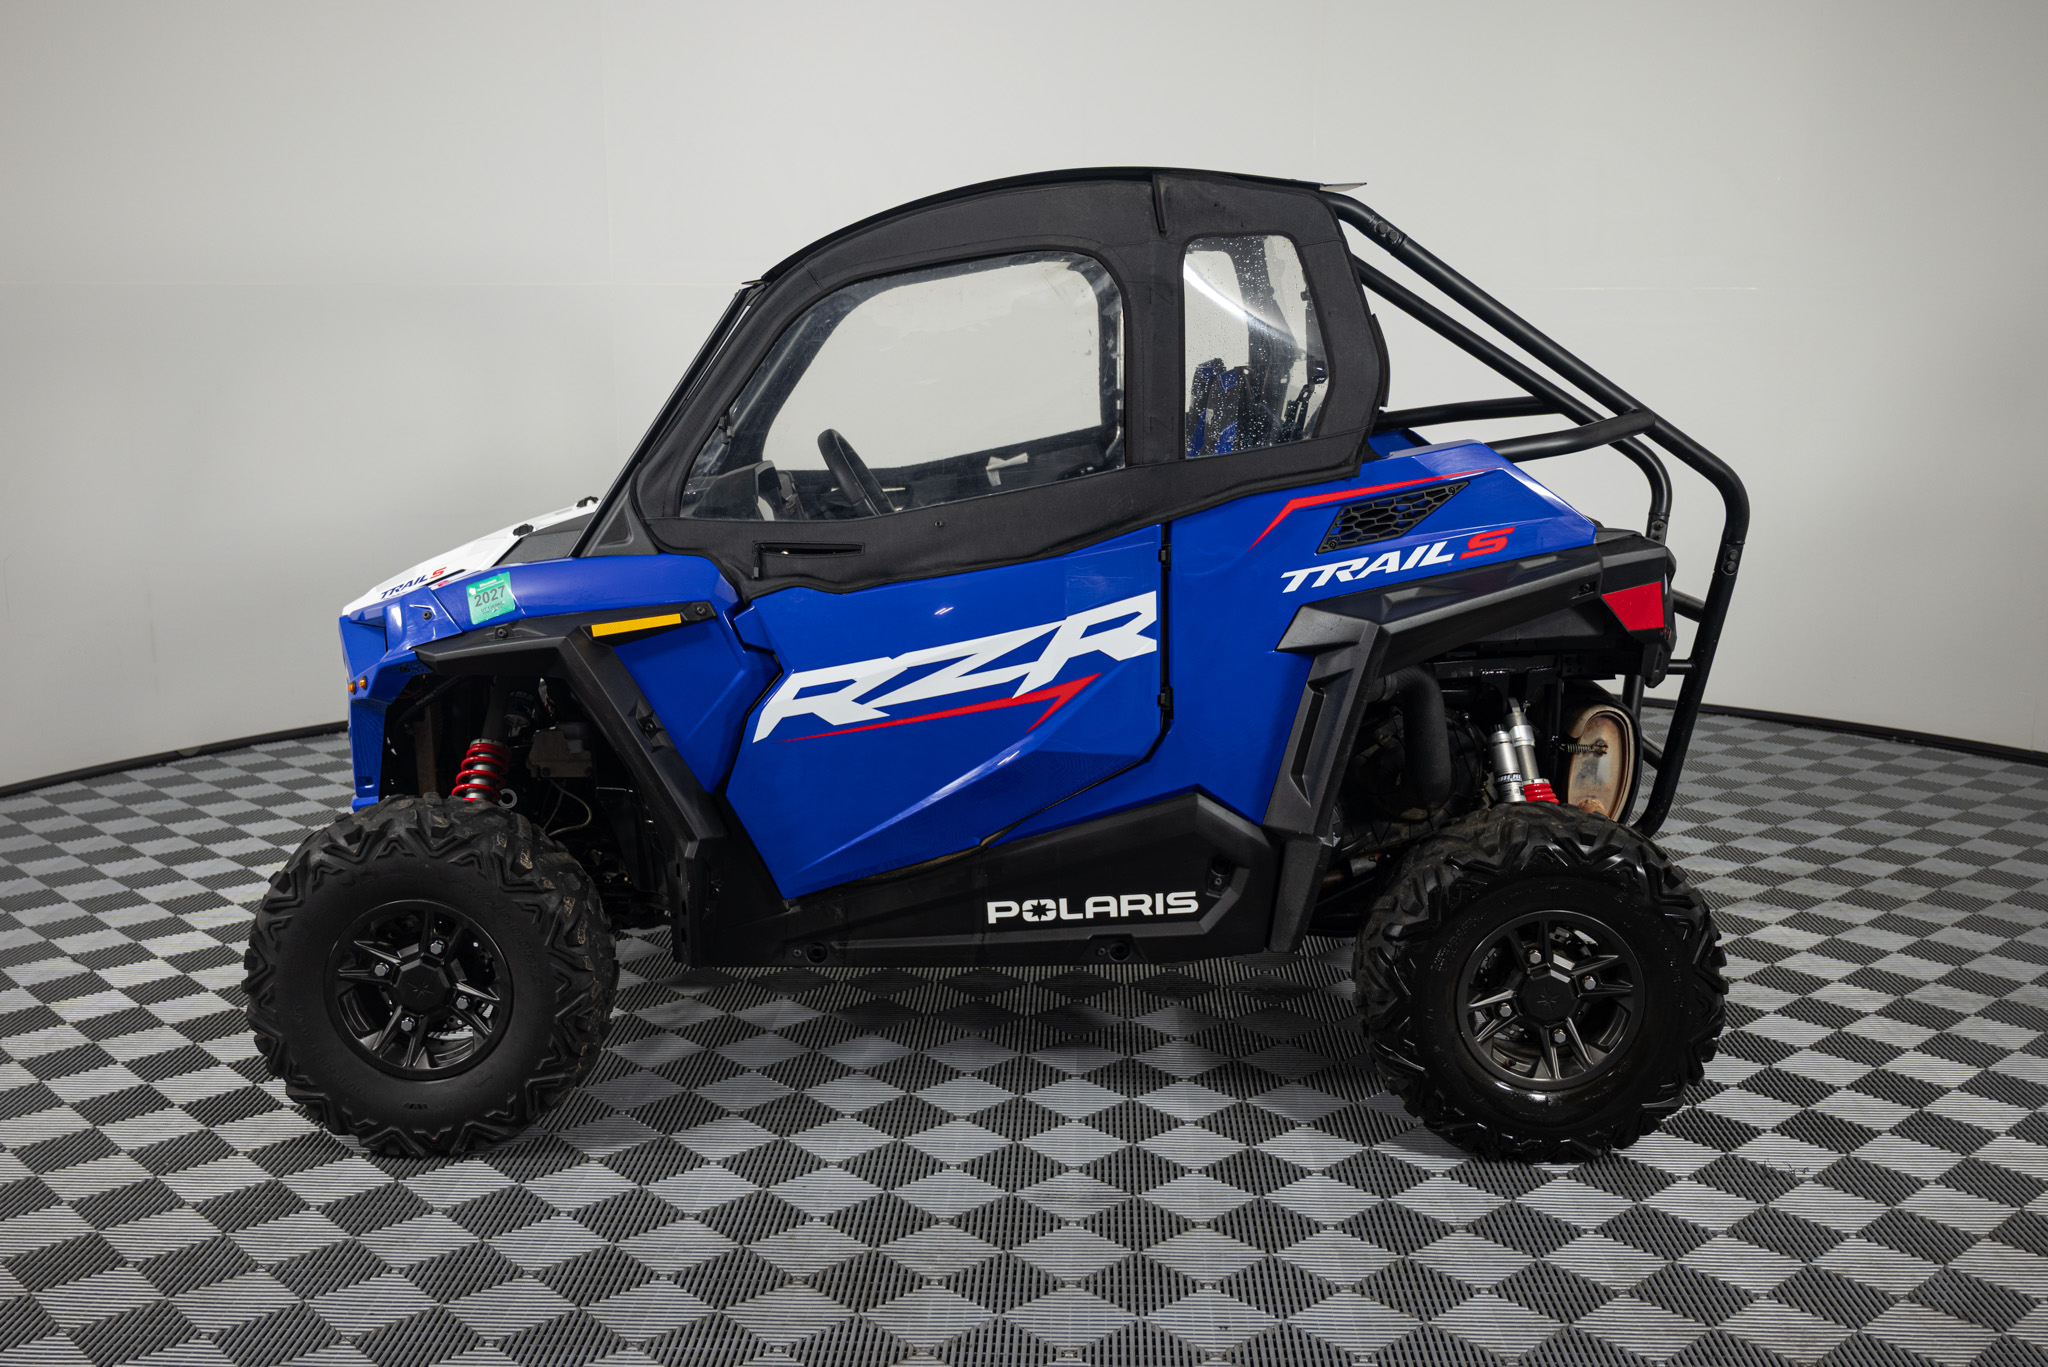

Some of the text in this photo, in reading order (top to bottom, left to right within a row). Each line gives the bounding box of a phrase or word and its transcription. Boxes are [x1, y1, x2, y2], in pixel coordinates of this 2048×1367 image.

[1280, 526, 1516, 593] TRAIL S
[380, 566, 448, 599] TRAIL S
[474, 584, 505, 607] 2027
[752, 590, 1158, 743] RZR
[986, 891, 1199, 924] POLARIS
